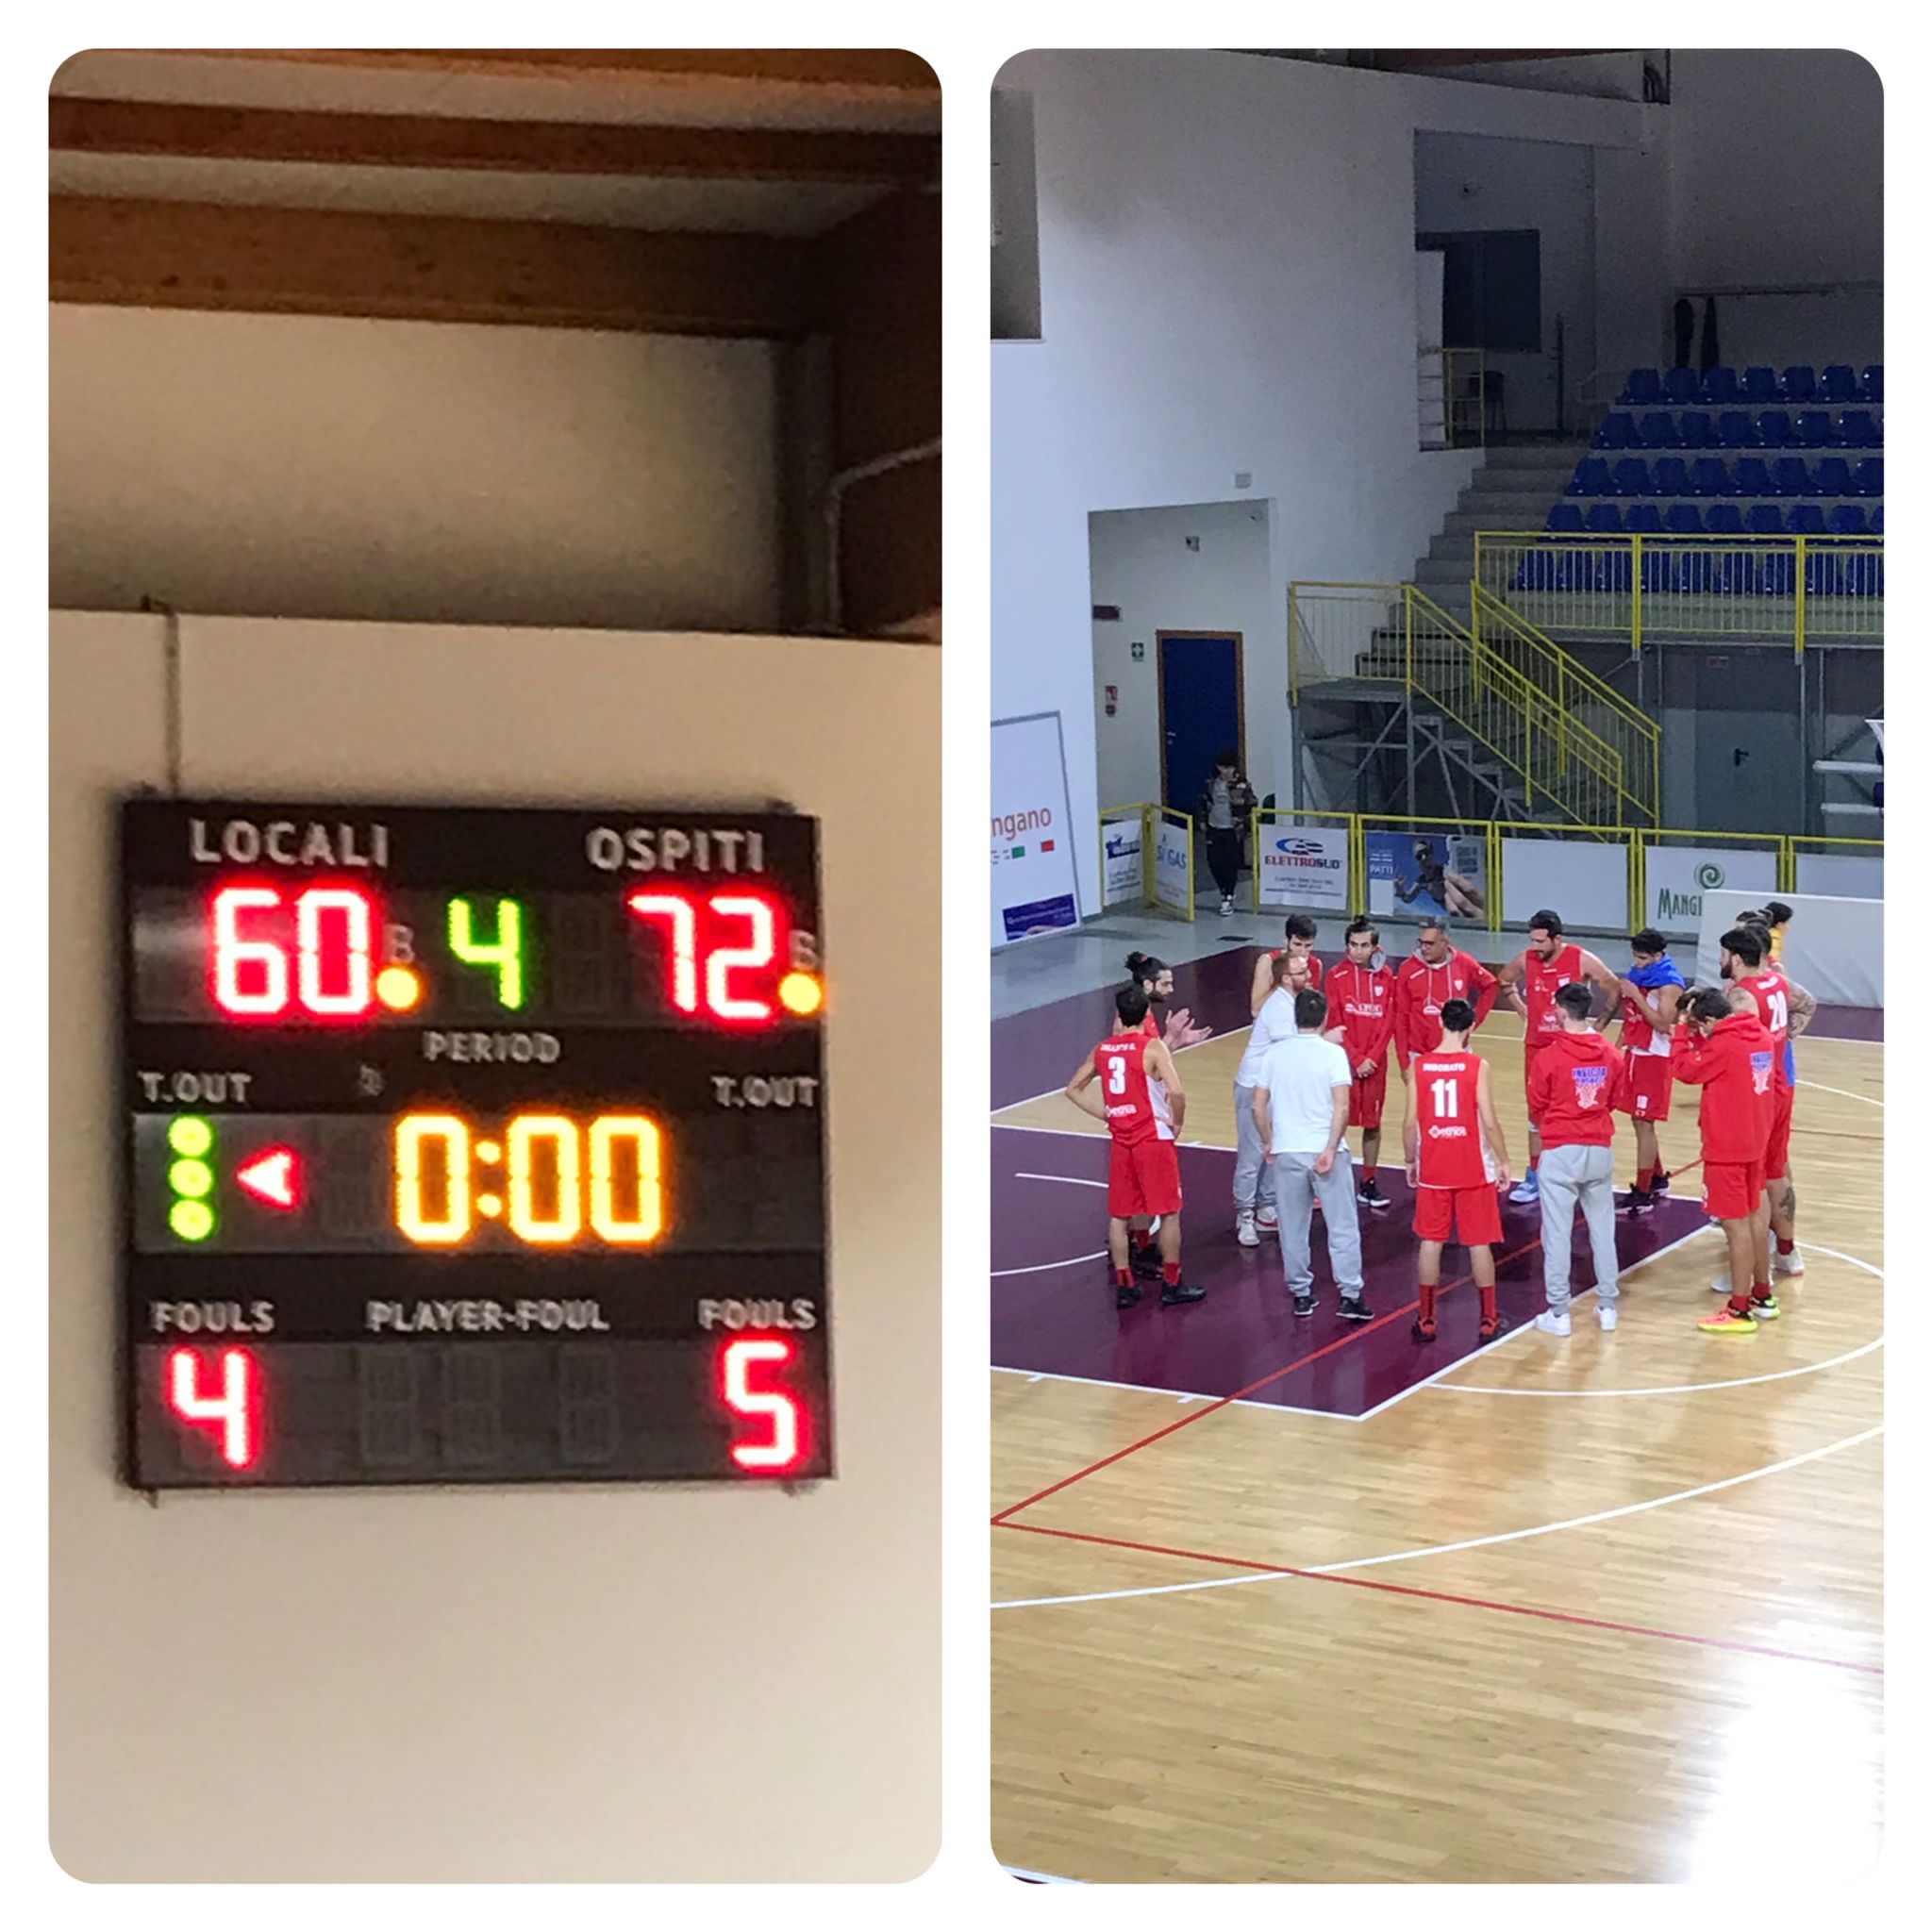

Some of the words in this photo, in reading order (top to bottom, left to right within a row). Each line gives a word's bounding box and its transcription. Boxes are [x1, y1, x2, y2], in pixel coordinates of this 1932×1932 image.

[190, 819, 389, 868] LOCALI
[991, 808, 1052, 841] ngano
[586, 826, 764, 874] OSPITI
[1265, 855, 1341, 870] ELETTROSUD
[213, 887, 370, 1014] 60
[448, 898, 522, 1011] 4
[627, 895, 775, 1019] 72
[1766, 991, 1788, 1033] 20
[423, 1030, 560, 1063] PERIOD
[138, 1070, 251, 1104] T.OUT
[710, 1074, 819, 1108] T.OUT
[1108, 1057, 1126, 1094] 3
[1431, 1078, 1457, 1118] 11
[394, 1114, 662, 1243] 0:00
[152, 1299, 275, 1334] FOULS
[366, 1299, 610, 1334] PLAYER-FOUL
[699, 1297, 817, 1332] FOULS
[171, 1347, 252, 1468] 4
[723, 1339, 799, 1469] 5
